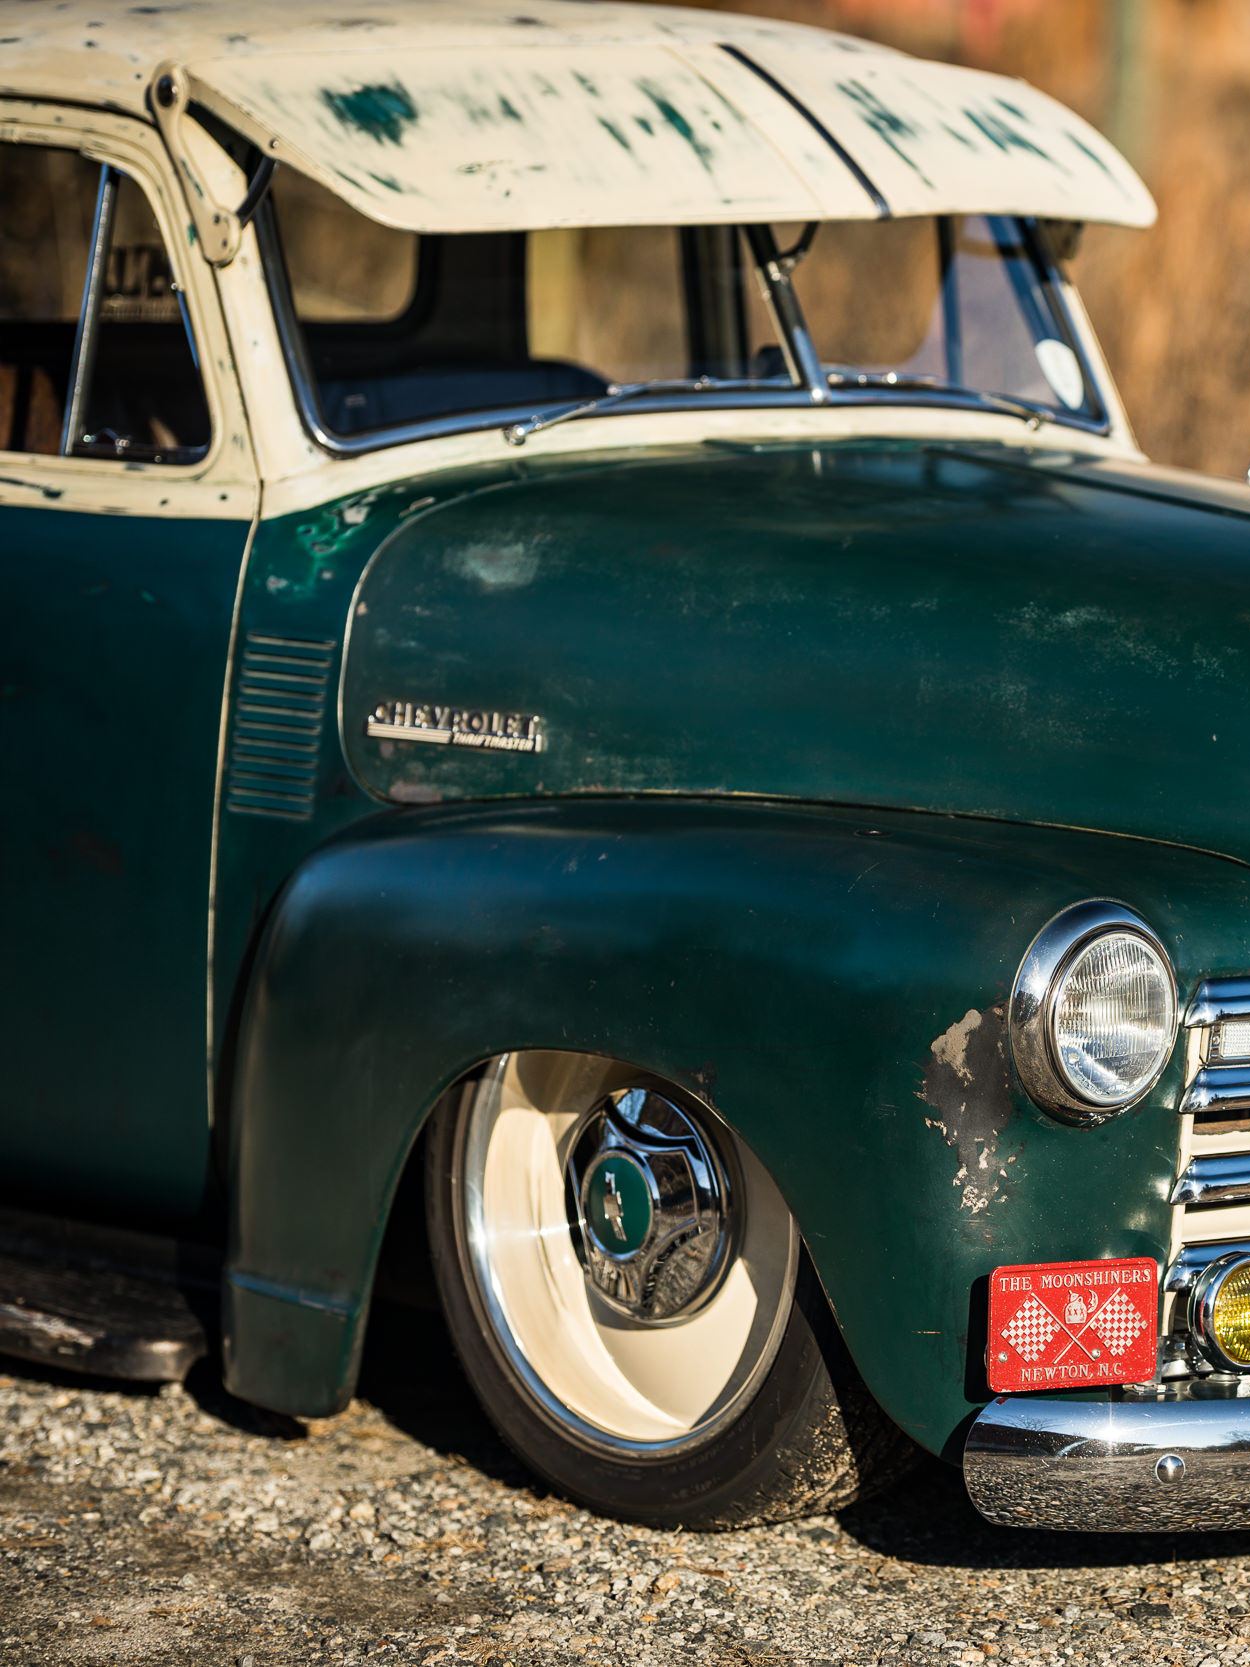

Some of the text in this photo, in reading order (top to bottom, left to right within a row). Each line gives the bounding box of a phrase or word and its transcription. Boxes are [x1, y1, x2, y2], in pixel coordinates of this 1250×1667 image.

[374, 702, 545, 739] CHEVROLET
[999, 1268, 1151, 1292] THE MOONSHINERS
[1020, 1362, 1126, 1382] NEWTON, N.C.
